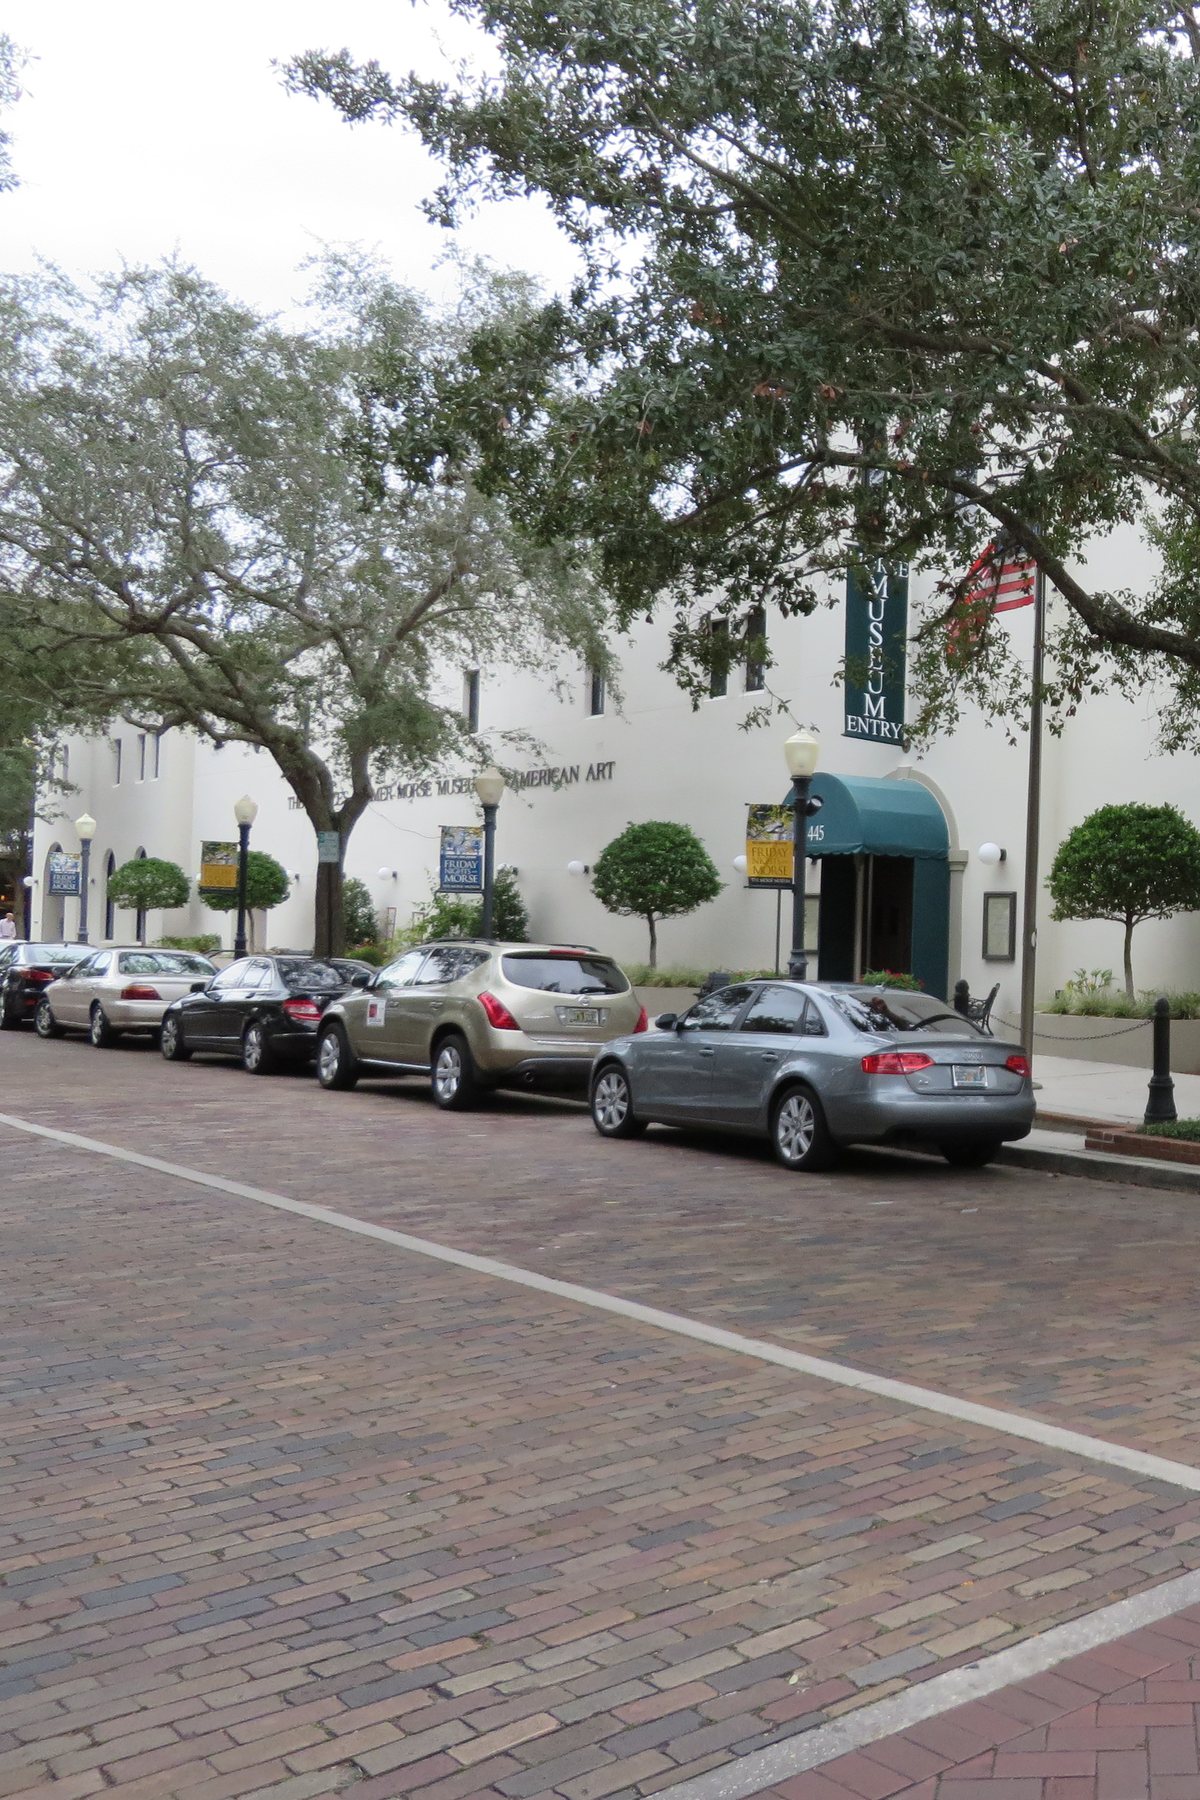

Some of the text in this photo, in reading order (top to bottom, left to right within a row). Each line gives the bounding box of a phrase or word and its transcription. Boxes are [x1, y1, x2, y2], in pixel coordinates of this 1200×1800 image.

[863, 575, 889, 720] MUSEUM
[846, 714, 903, 739] ENTRY
[397, 780, 433, 799] MORSE
[586, 761, 616, 781] ART
[807, 823, 825, 842] 445
[752, 847, 790, 857] FRIDAY
[445, 860, 479, 869] FRIDAY
[752, 865, 788, 876] MORSE
[445, 874, 479, 883] MORSE
